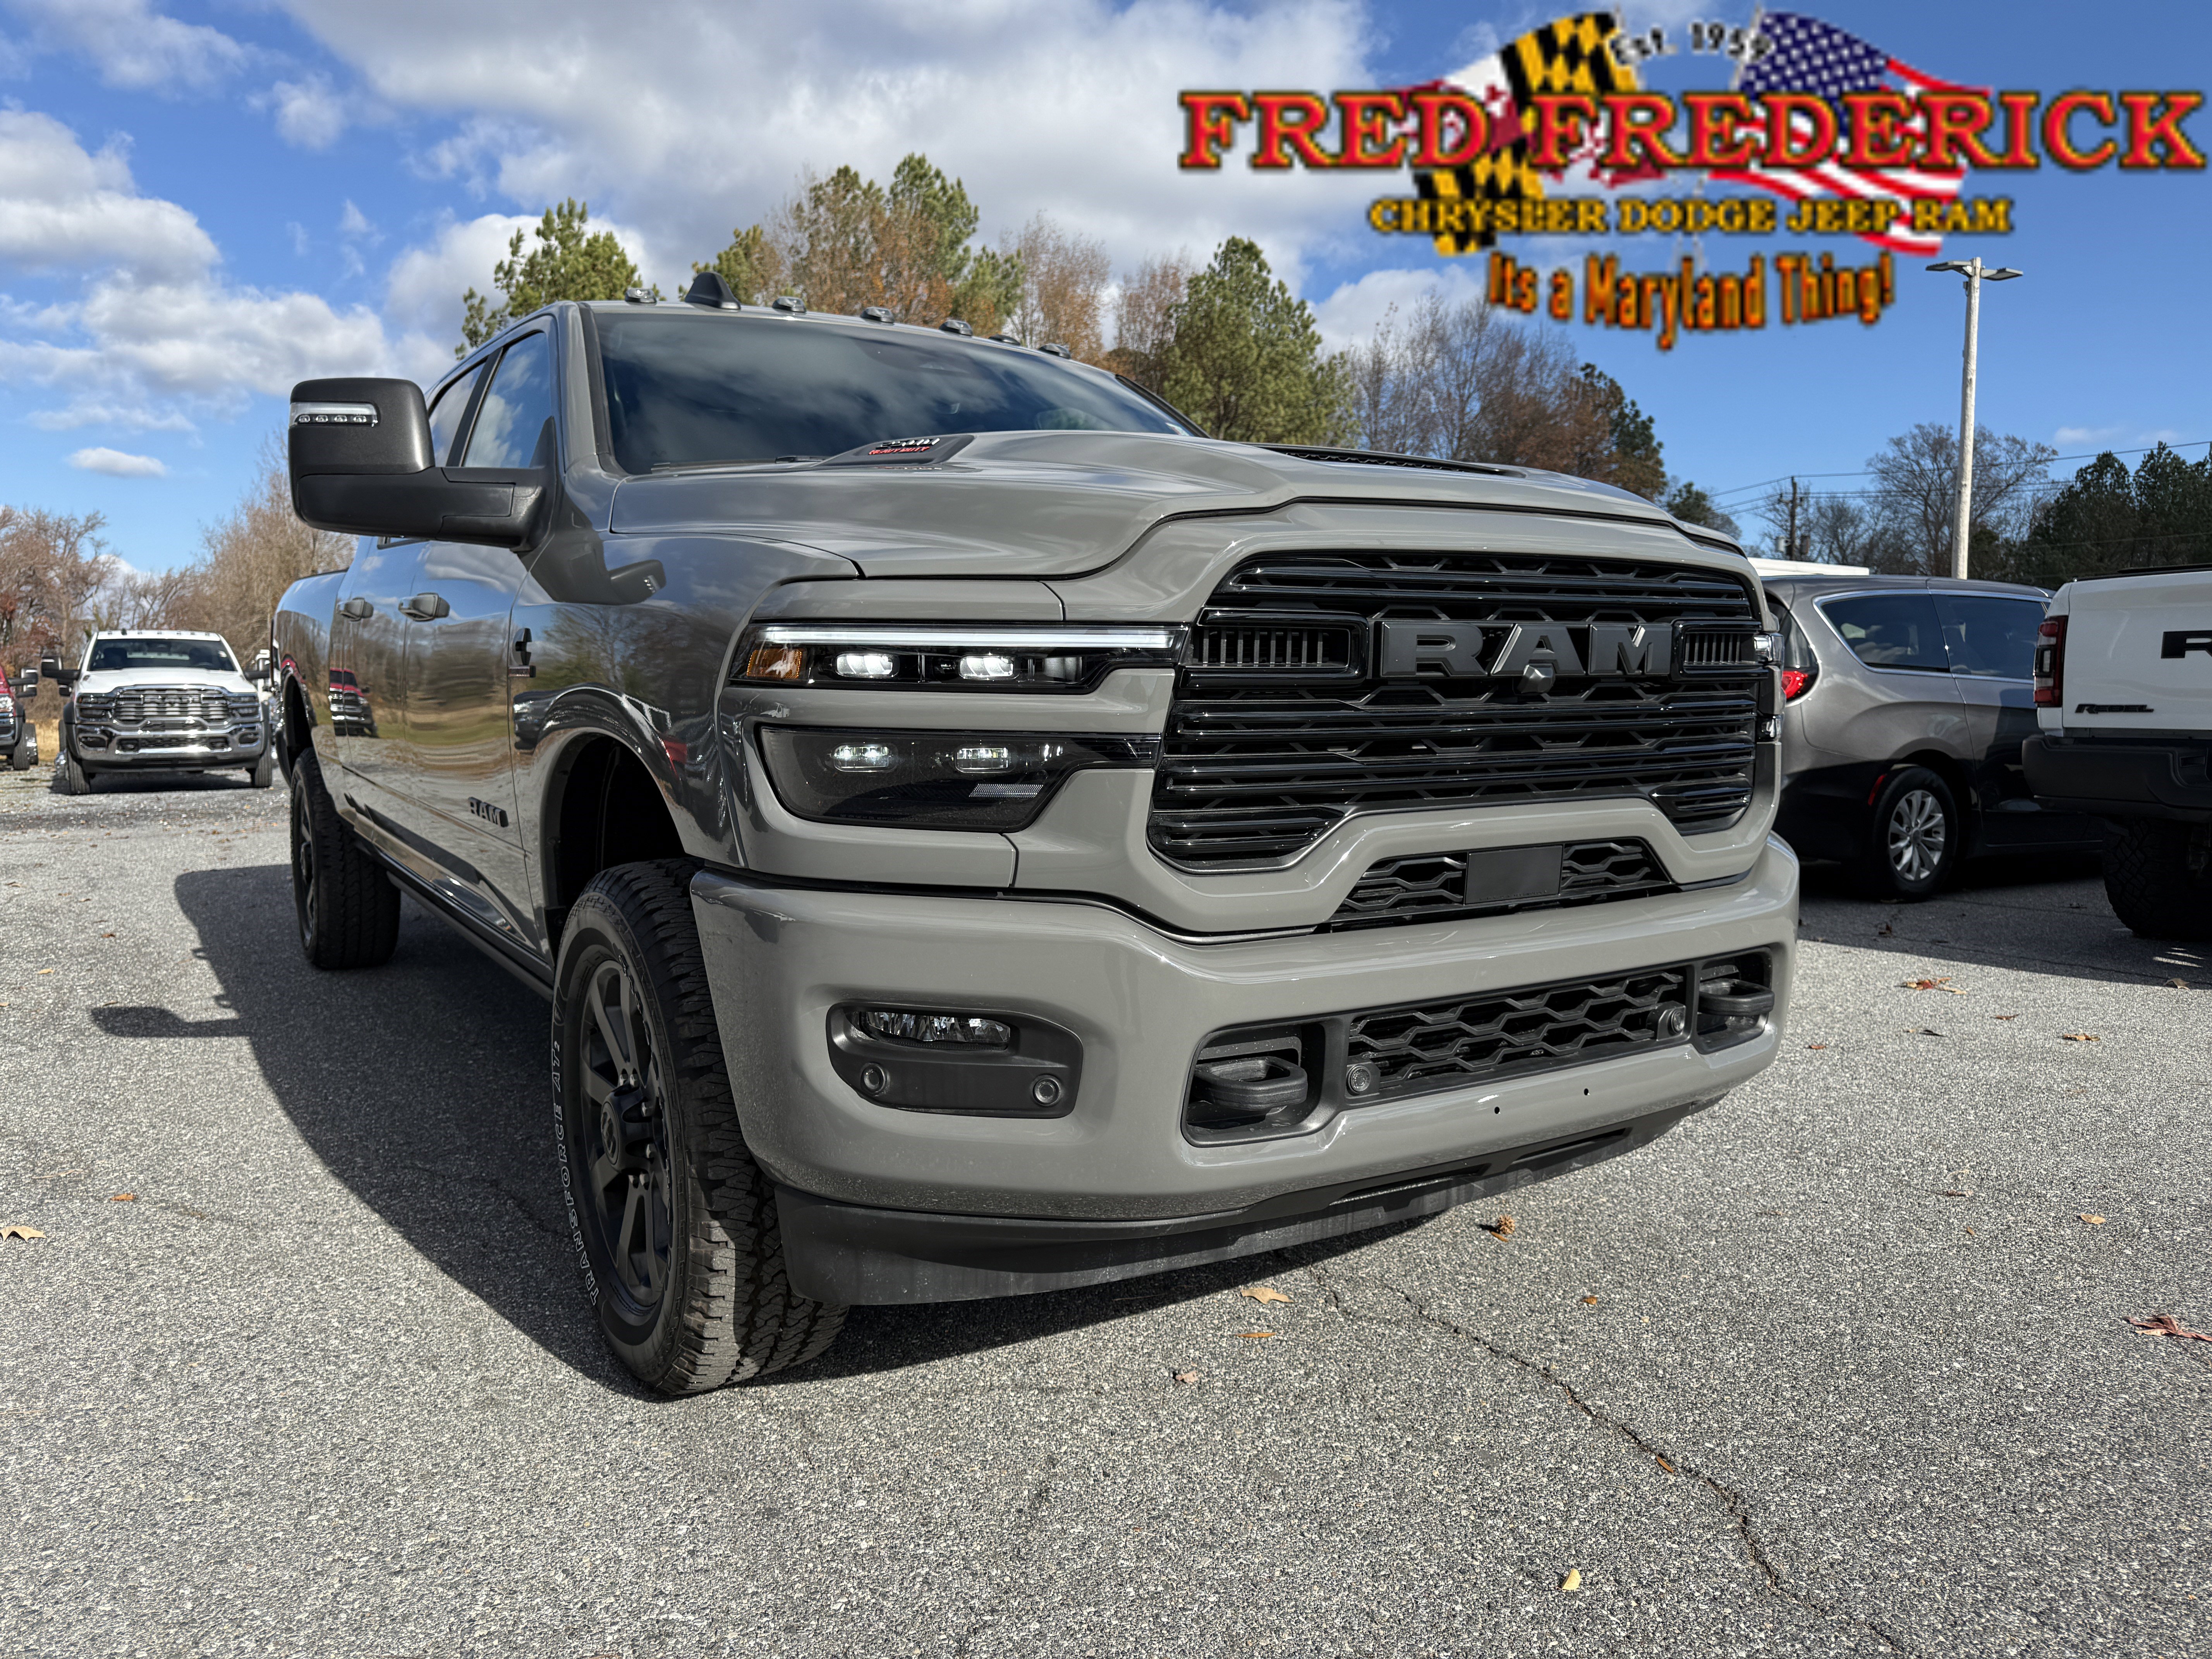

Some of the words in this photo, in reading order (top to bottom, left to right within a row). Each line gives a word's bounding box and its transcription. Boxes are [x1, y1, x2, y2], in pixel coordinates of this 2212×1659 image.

[1382, 621, 1673, 677] RAM
[468, 797, 509, 828] RAM
[554, 1103, 599, 1306] TRANSFORCE
